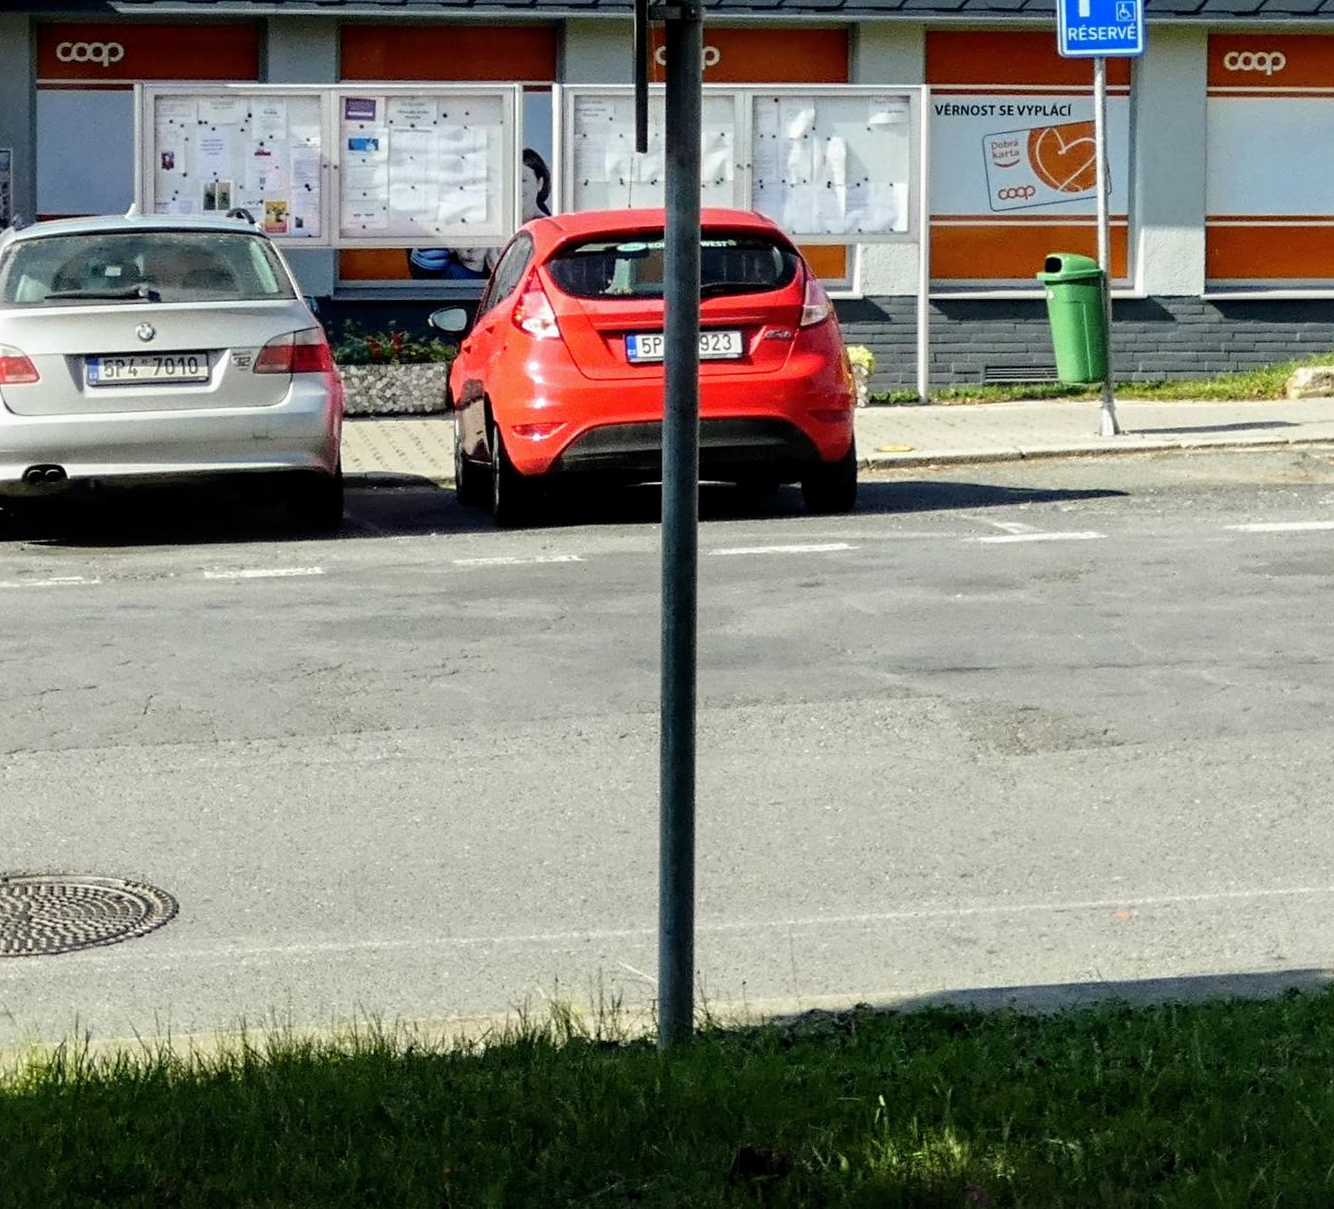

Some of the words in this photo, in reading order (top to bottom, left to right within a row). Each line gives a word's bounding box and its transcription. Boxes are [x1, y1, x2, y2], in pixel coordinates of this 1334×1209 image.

[1068, 23, 1136, 41] RÉSERVÉ
[56, 42, 125, 67] coop
[654, 45, 720, 70] cp
[1224, 51, 1286, 75] coop
[999, 105, 1014, 116] SE
[1017, 103, 1072, 116] VYPLÁCÍ
[998, 185, 1036, 200] coop
[103, 358, 138, 377] 5P4
[153, 356, 199, 376] 7010
